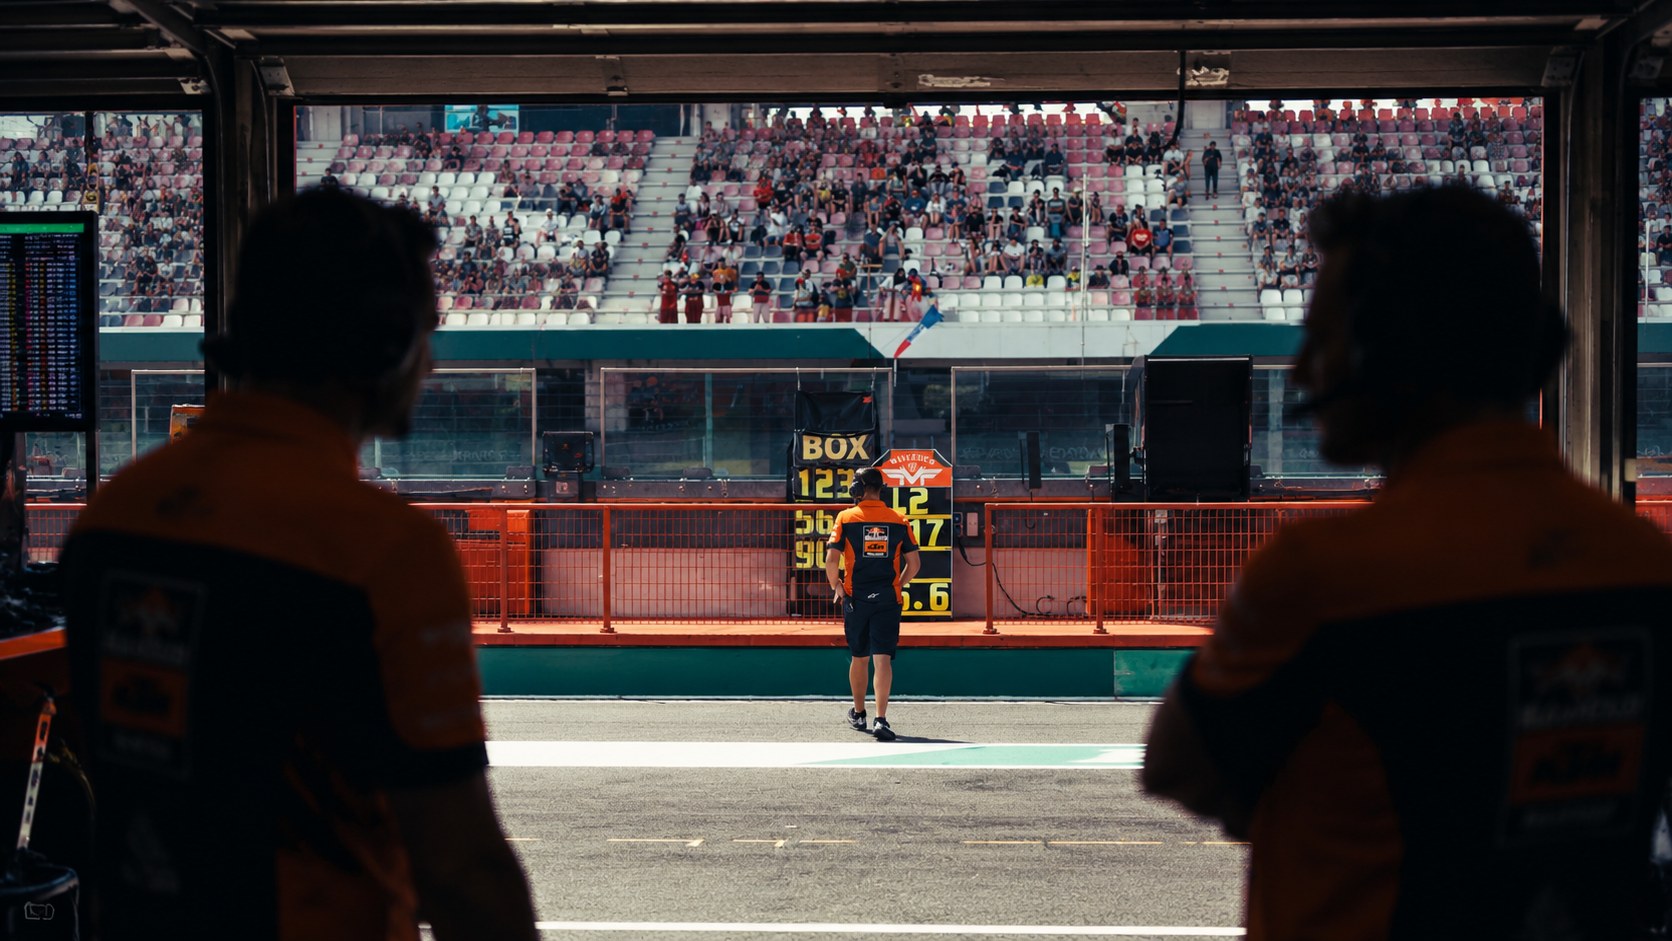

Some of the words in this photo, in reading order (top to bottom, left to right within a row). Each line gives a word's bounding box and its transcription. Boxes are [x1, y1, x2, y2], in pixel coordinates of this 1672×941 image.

[803, 434, 869, 460] BOX
[799, 467, 857, 498] 123
[795, 541, 845, 569] 90
